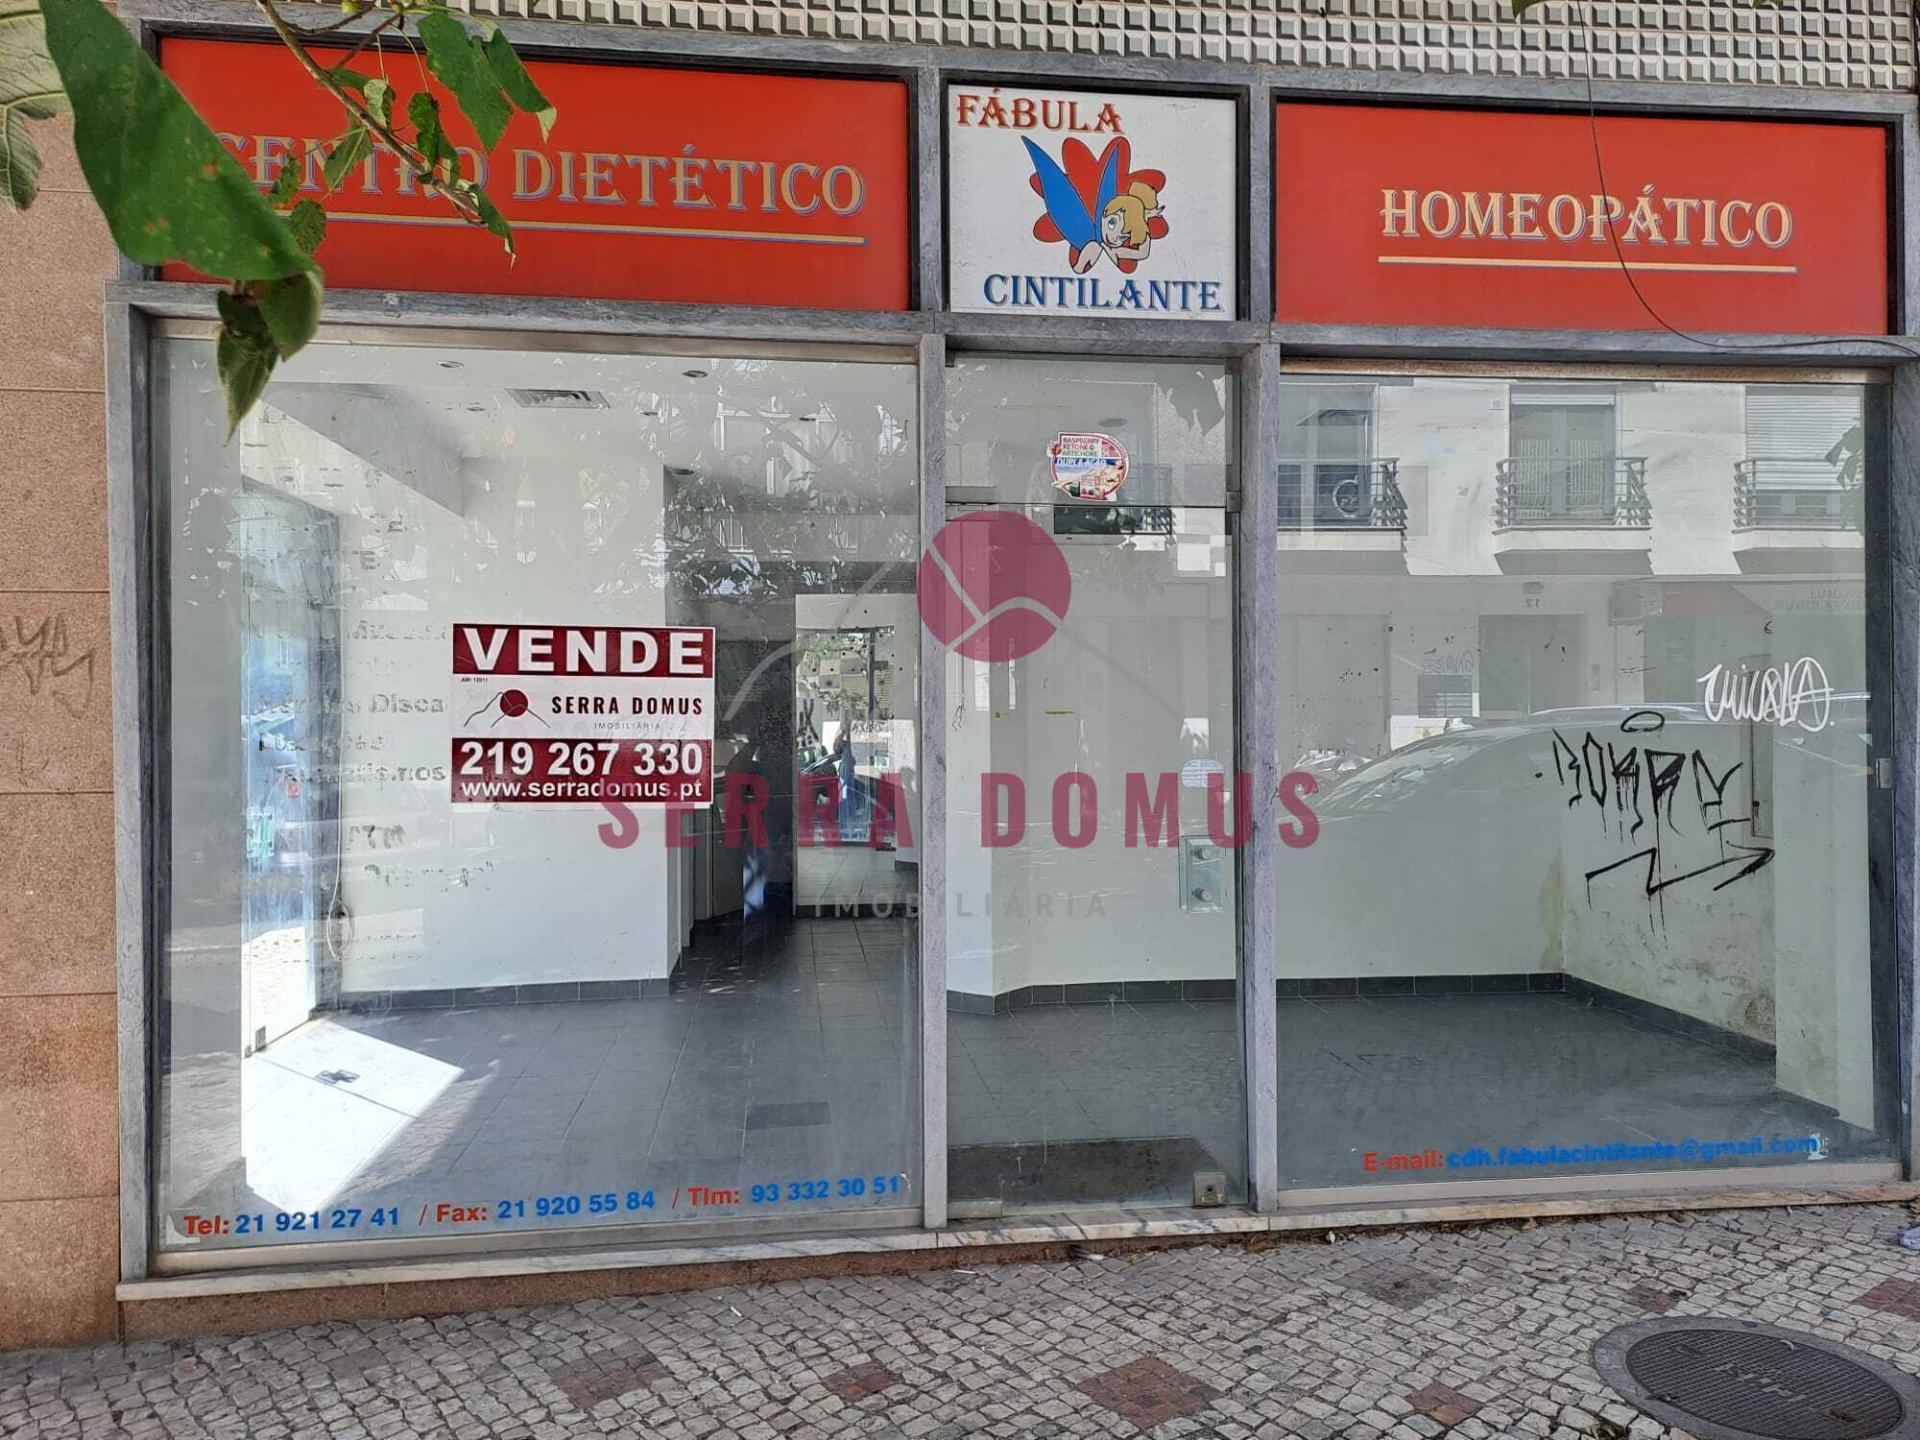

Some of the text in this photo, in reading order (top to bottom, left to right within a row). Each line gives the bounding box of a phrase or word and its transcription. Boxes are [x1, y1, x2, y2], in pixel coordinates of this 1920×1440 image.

[956, 87, 1126, 133] FÁBULA
[511, 143, 867, 216] DIETÉTICO
[1379, 183, 1795, 249] HOMEOPÁTICO
[983, 273, 1223, 312] CINTILANTE
[463, 628, 706, 675] VENDE
[552, 695, 704, 716] SERRA DOMUS
[461, 741, 704, 776] 219 267 330
[462, 780, 703, 800] www.serradomus.pt
[1364, 1151, 1445, 1172] E-mail:
[183, 1215, 229, 1235] Tel:
[235, 1215, 264, 1234] 21
[276, 1212, 321, 1231] 921
[331, 1209, 361, 1228] 27
[370, 1207, 399, 1226] 41
[436, 1203, 487, 1223] Fax:
[497, 1201, 525, 1219] 21
[535, 1196, 581, 1216] 920
[588, 1194, 618, 1213] 55
[626, 1191, 655, 1210] 84
[688, 1187, 740, 1207] Tlm:
[751, 1184, 780, 1203] 93
[787, 1180, 830, 1200] 332
[837, 1178, 866, 1196] 30
[873, 1176, 899, 1194] 51
